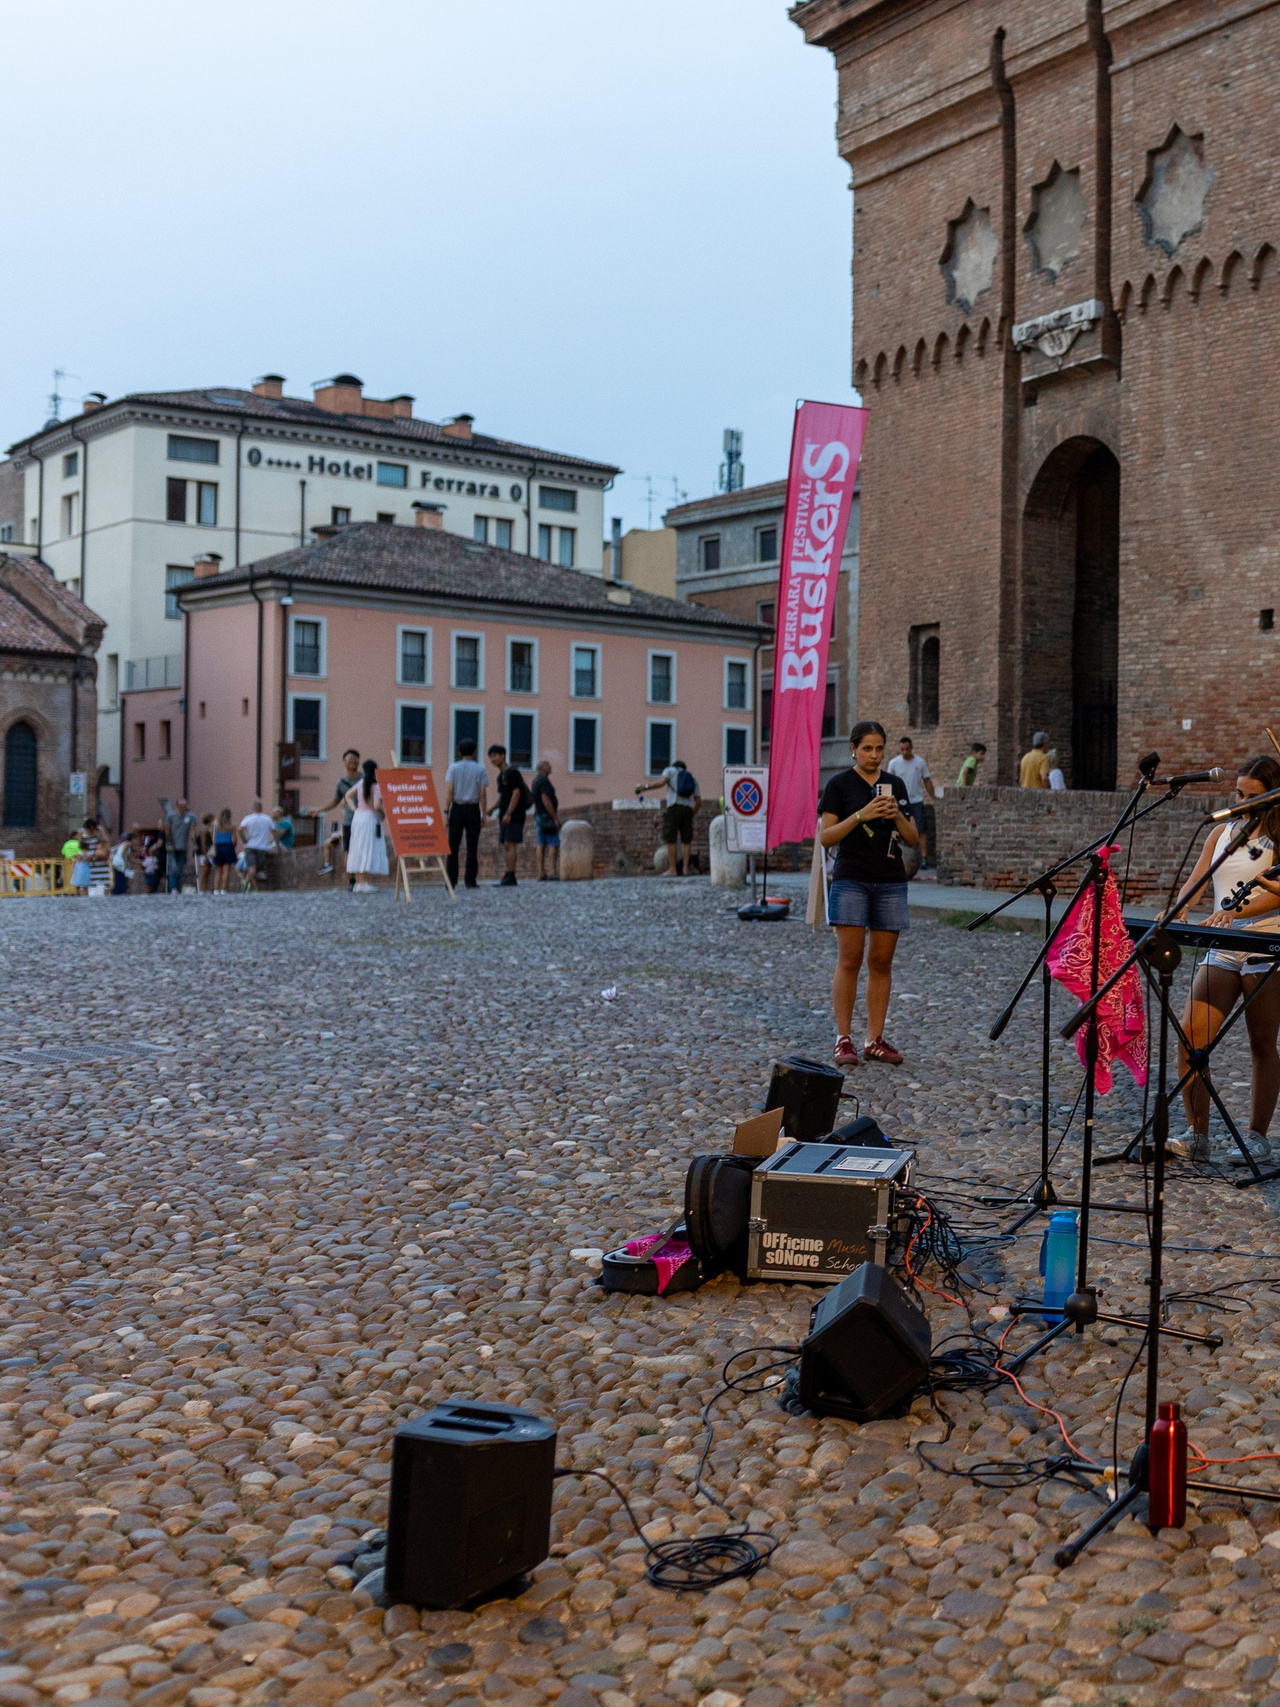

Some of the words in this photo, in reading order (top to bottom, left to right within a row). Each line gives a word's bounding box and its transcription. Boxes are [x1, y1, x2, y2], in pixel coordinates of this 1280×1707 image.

[307, 454, 373, 480] Hotel
[420, 470, 500, 498] Ferrara
[792, 480, 812, 557] FESTIVAL
[785, 576, 802, 651] FERRARA
[387, 783, 427, 793] Spettacoli
[401, 805, 434, 813] Castello
[762, 1232, 824, 1252] OFFicine
[827, 1238, 868, 1255] Music
[765, 1249, 820, 1268] sONore
[825, 1255, 868, 1271] Schoo
